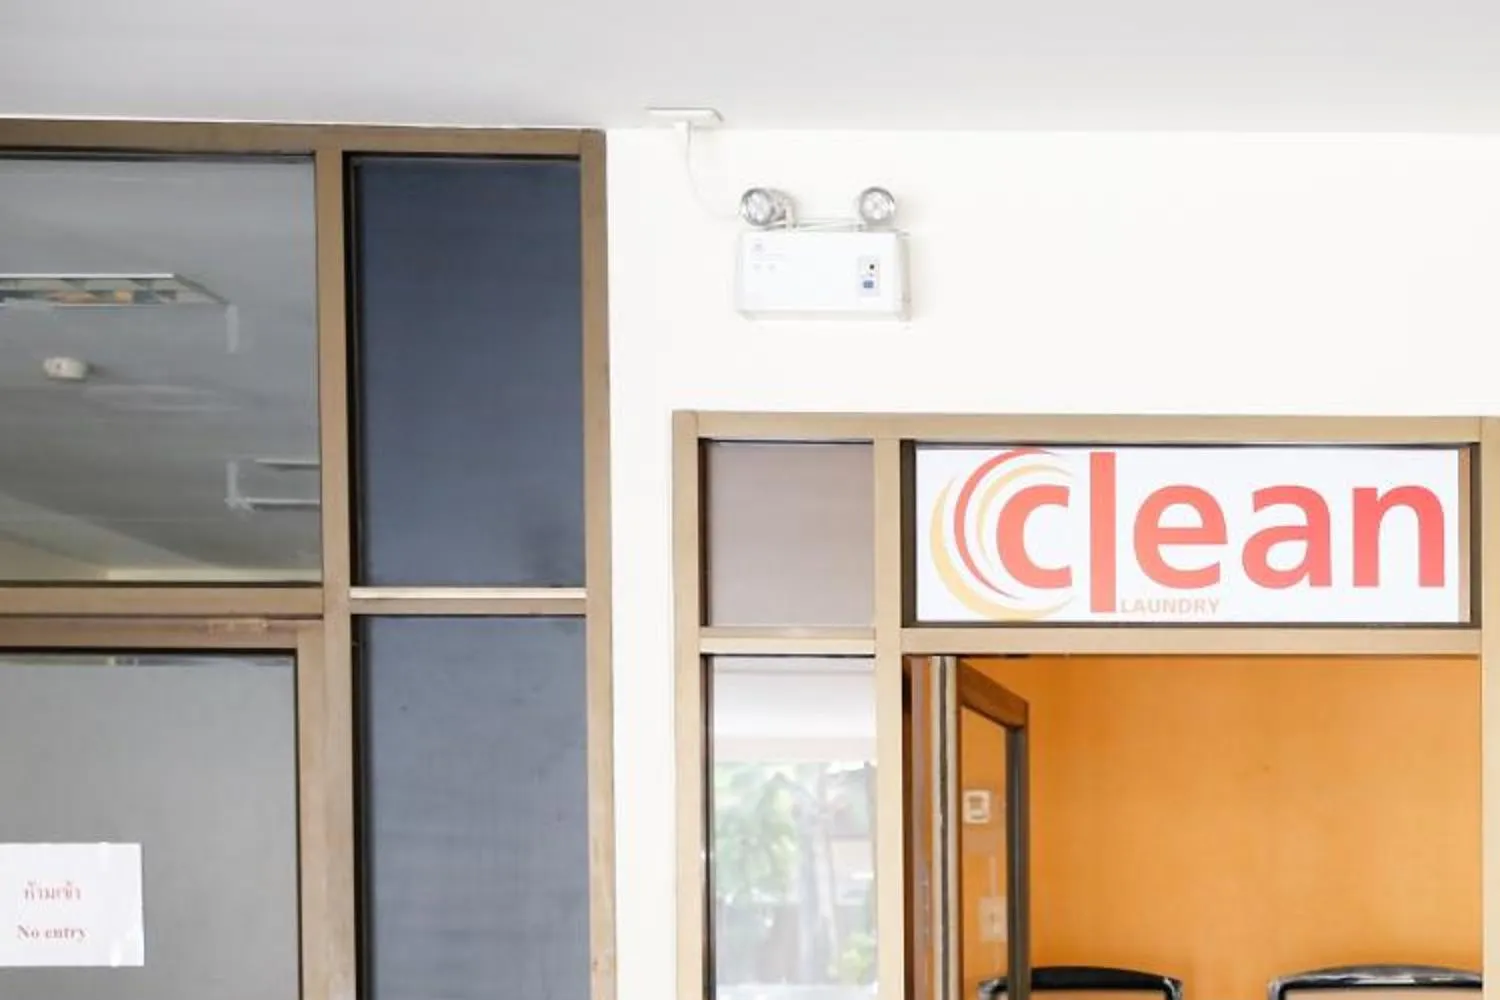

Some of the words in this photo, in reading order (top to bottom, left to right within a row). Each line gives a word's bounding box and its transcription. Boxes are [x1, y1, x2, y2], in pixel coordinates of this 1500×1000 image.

[995, 451, 1446, 613] clean
[1120, 598, 1220, 614] LAUNDRY
[17, 924, 40, 939] No
[45, 926, 87, 943] entry
